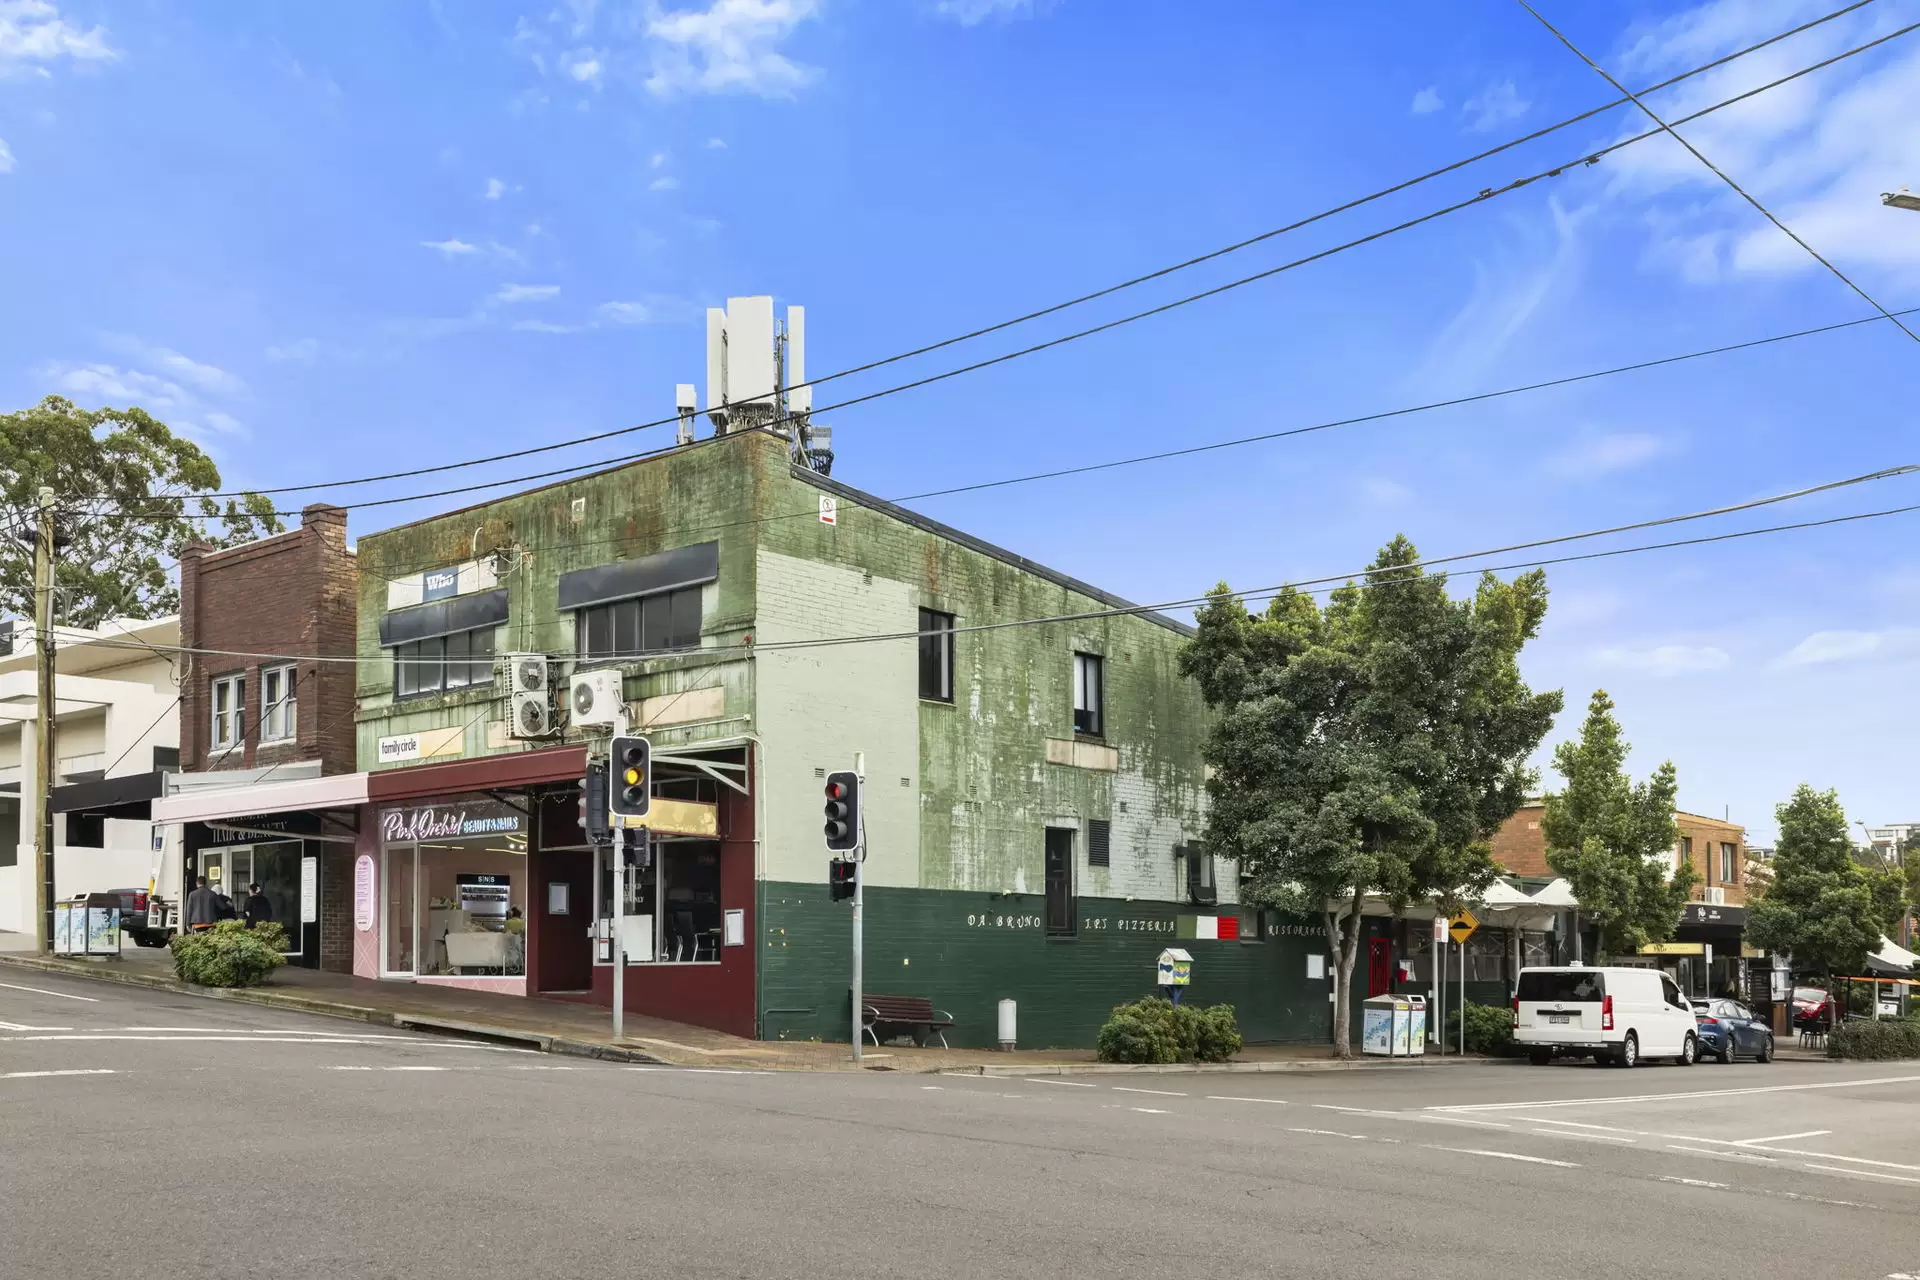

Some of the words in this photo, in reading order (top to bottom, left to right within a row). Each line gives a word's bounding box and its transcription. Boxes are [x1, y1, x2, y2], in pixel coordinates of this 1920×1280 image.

[381, 740, 400, 756] family
[400, 738, 417, 753] circle
[383, 812, 418, 841] Pink
[418, 808, 466, 840] Orchid
[996, 915, 1041, 929] BRUNO
[1117, 919, 1175, 932] PIZZERIA
